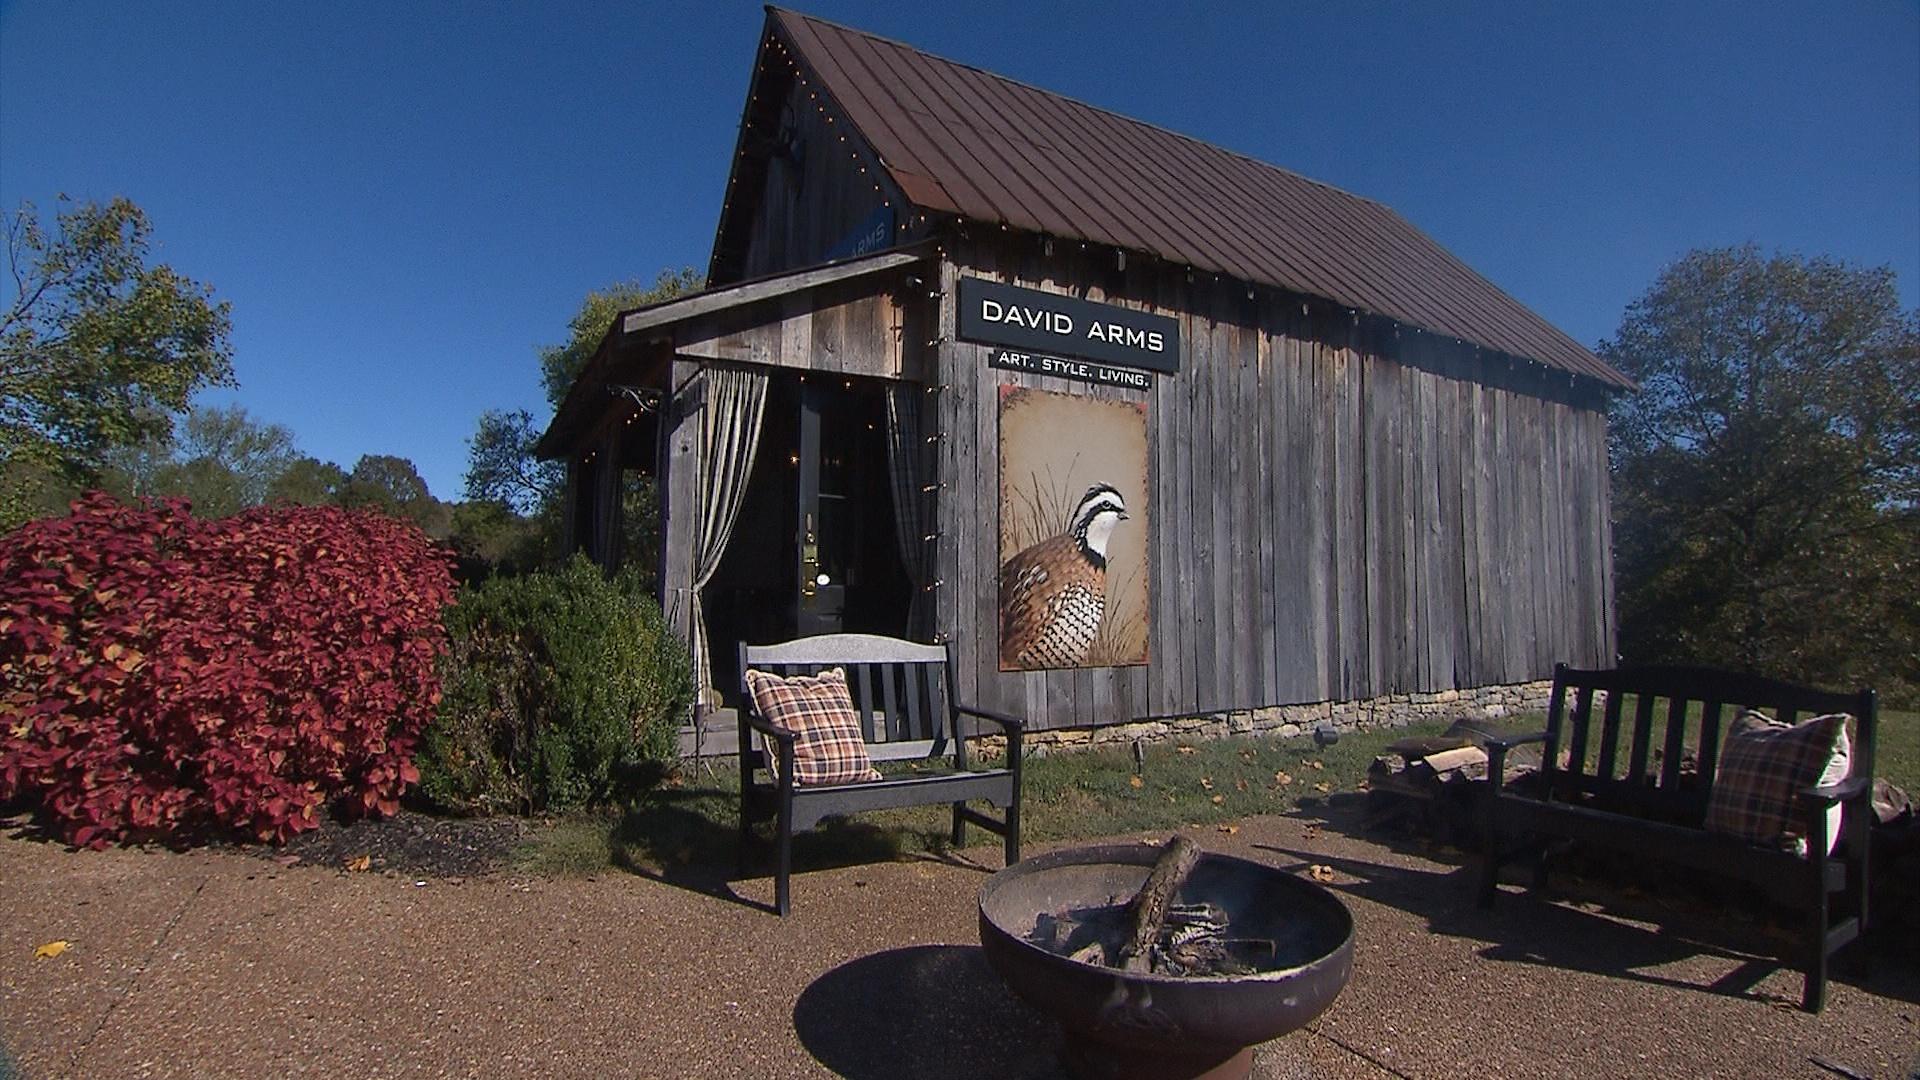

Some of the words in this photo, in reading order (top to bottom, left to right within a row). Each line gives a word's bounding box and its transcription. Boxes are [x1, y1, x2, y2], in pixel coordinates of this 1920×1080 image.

[982, 300, 1073, 334] DAVID
[1087, 321, 1164, 352] ARMS
[998, 351, 1035, 369] ART.
[1041, 358, 1093, 377] STYLE.
[1099, 368, 1149, 387] LIVING.
